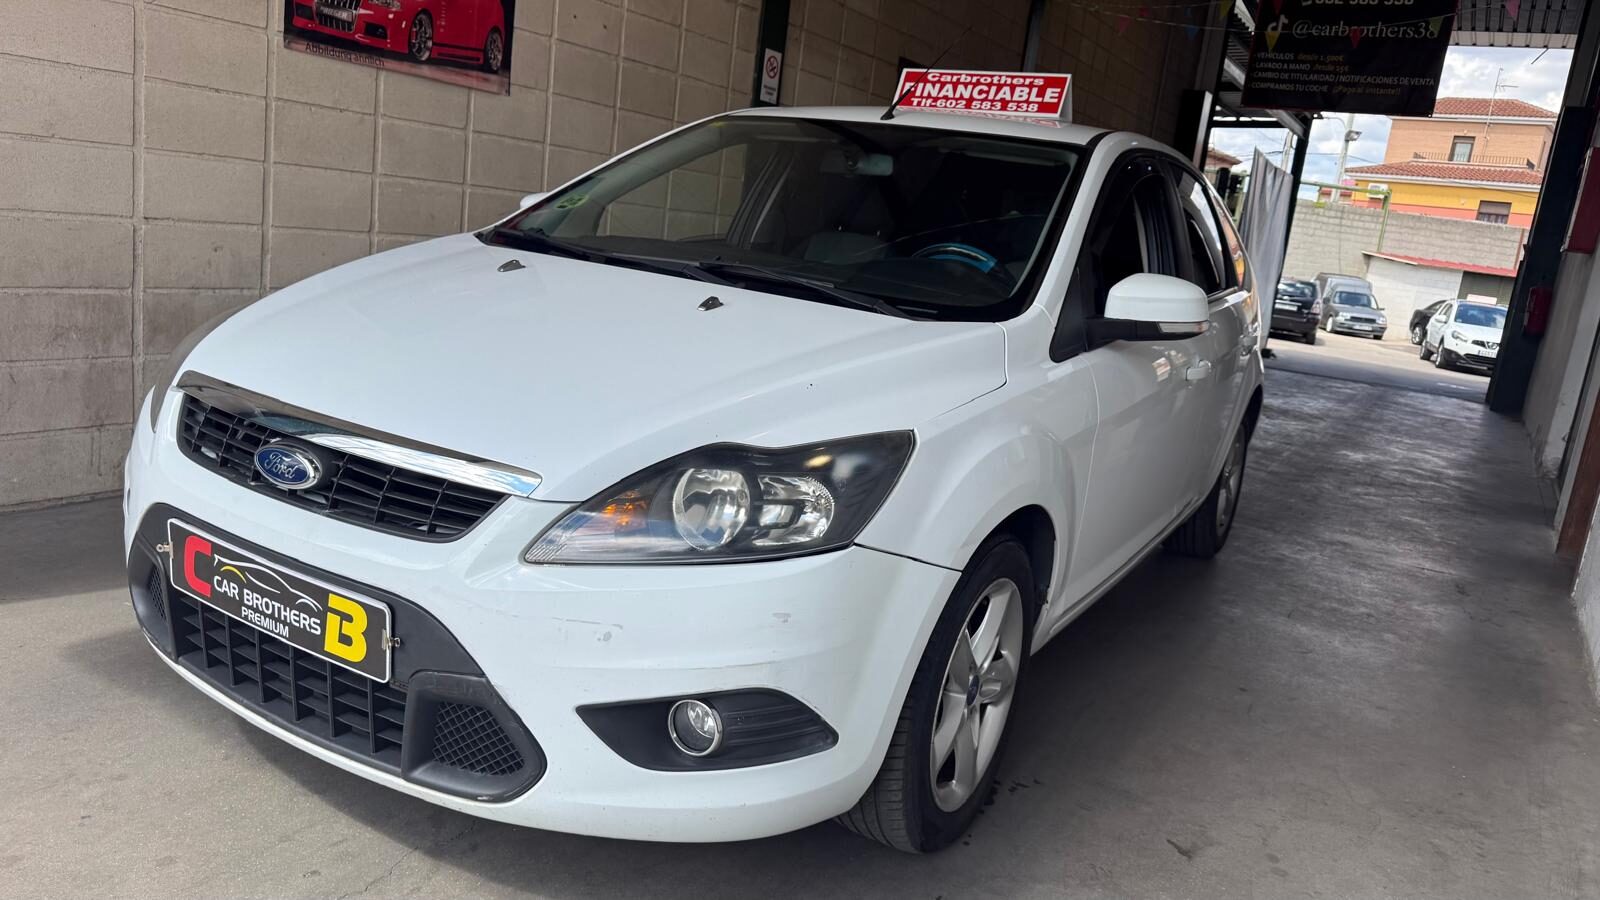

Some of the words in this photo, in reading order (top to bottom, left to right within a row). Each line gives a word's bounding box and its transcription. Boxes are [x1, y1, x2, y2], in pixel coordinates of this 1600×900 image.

[1292, 20, 1439, 39] @carbothers38
[1289, 63, 1311, 71] MANO
[927, 73, 1045, 86] Carbrothers
[1251, 82, 1295, 91] COMPRAMOS
[1305, 84, 1329, 92] COCHE
[1253, 71, 1280, 79] CAMBIO
[1290, 73, 1335, 82] TITULARIDAD
[1340, 74, 1399, 85] NOTIFICACIONES
[1399, 77, 1410, 85] DE
[1410, 77, 1435, 86] VENTA
[902, 82, 1062, 103] FINANCIABLE
[911, 97, 967, 109] Tlf-602
[971, 100, 1002, 111] 583
[1006, 101, 1039, 112] 538
[264, 451, 297, 480] Ford
[184, 535, 212, 598] C
[213, 575, 240, 601] CAR
[243, 591, 322, 636] BROTHERS
[241, 608, 290, 639] PREMIUM
